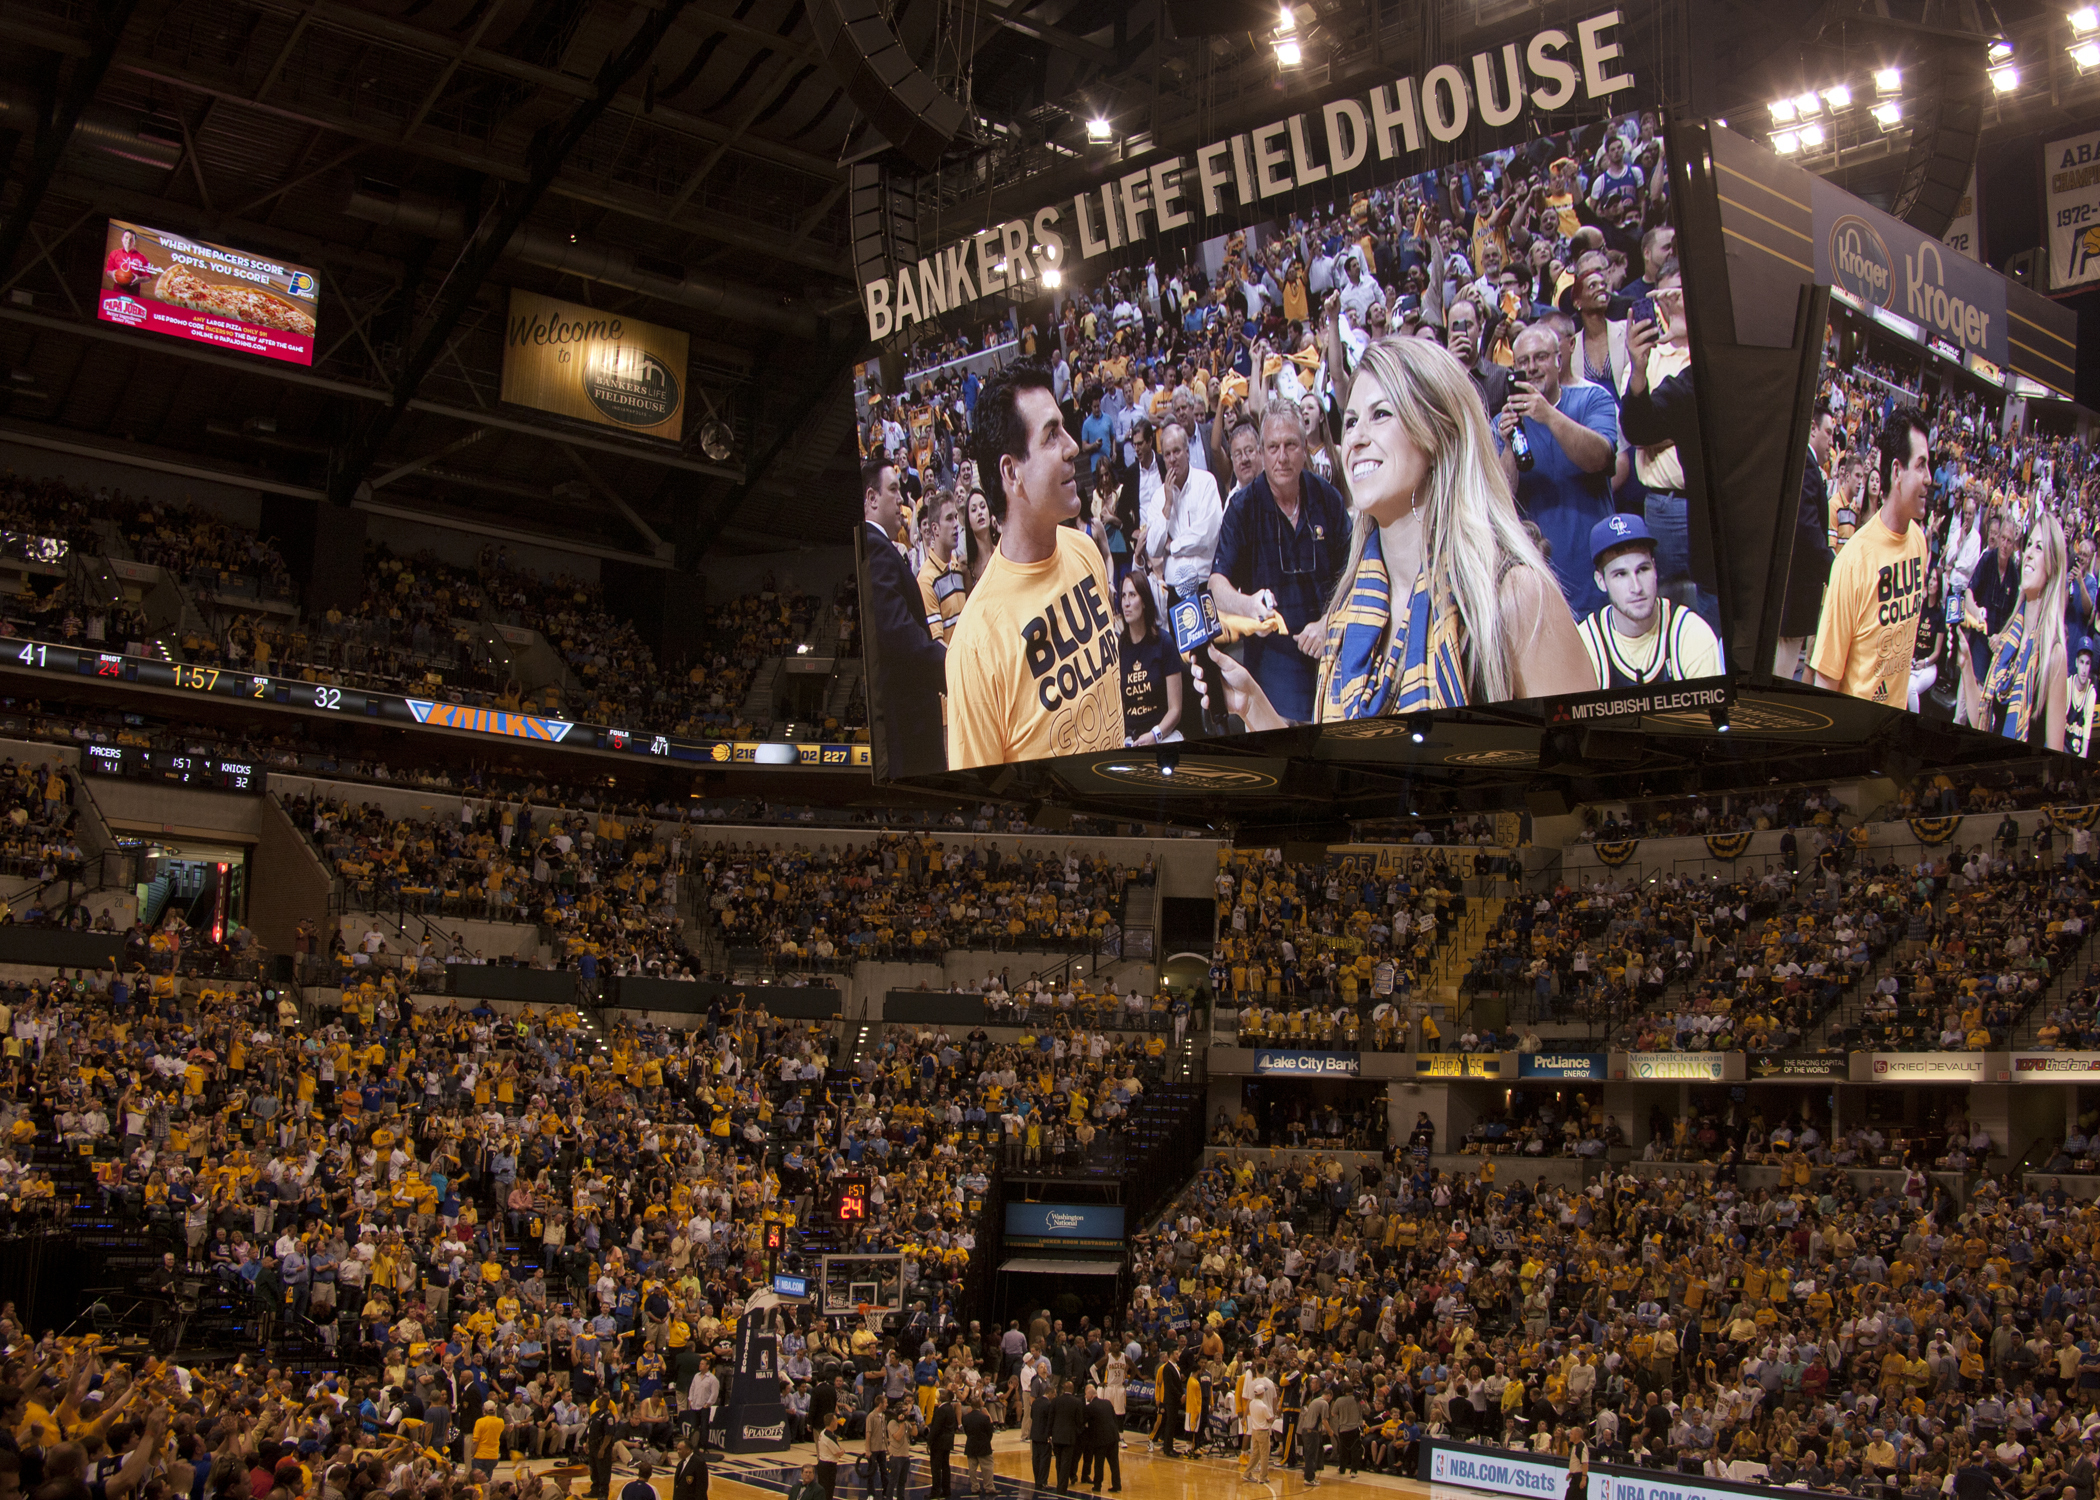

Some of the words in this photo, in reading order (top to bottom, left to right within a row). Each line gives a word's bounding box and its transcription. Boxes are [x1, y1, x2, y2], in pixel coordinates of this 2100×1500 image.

[865, 207, 1069, 341] BANKERS
[1074, 156, 1194, 260] LIFE
[1198, 9, 1635, 217] FIELDHOUSE
[2057, 201, 2100, 227] 1972-
[159, 237, 191, 253] WHEN
[193, 245, 211, 258] THE
[212, 250, 250, 267] PACERS
[250, 260, 284, 276] SCORE
[209, 262, 232, 275] YOU
[234, 268, 270, 284] SCORE!
[1839, 229, 1889, 301] Kroger
[1905, 241, 1990, 350] Kroger
[104, 300, 122, 313] PAPA
[153, 314, 165, 322] USE
[165, 316, 187, 326] PROMO
[188, 321, 204, 330] CODE
[234, 332, 246, 340] THE
[246, 334, 258, 342] DAY
[258, 336, 276, 346] AFTER
[276, 341, 287, 349] THE
[288, 344, 304, 353] GAME
[206, 318, 225, 328] LARGE
[226, 323, 242, 332] PIZZA
[243, 327, 258, 335] ONLY
[509, 312, 625, 347] Welcome
[191, 329, 213, 339] ONLINE
[219, 336, 267, 351] PAPAJOHNS.COM
[558, 347, 571, 363] to
[596, 376, 648, 395] BANKERS
[648, 388, 667, 400] LIFE
[594, 389, 667, 413] FIELDHOUSE
[611, 405, 647, 417] INDIANAPOLIS
[1877, 556, 1922, 603] BLUE
[1021, 574, 1110, 680] BLUE
[1876, 616, 1919, 659] GOL
[19, 643, 47, 667] 41
[101, 654, 122, 663] SHOT
[99, 660, 119, 677] 24
[1039, 628, 1119, 713] COLLAR
[172, 665, 220, 691] 1:57
[253, 676, 269, 685] QTR
[1127, 670, 1148, 684] KEEP
[254, 683, 265, 698] 2
[1125, 681, 1152, 697] CALM
[314, 686, 341, 710] 32
[1572, 698, 1650, 719] MITSUBISHI
[1653, 689, 1726, 710] ELECTRIC
[609, 729, 629, 738] FOULS
[614, 736, 623, 749] 5
[651, 742, 669, 755] 4/1
[89, 745, 122, 759] PACERS
[801, 750, 817, 761] 02
[823, 751, 847, 763] 227
[104, 761, 118, 772] 41
[173, 757, 191, 768] 1:57
[221, 762, 251, 775] KNICKS
[183, 773, 190, 782] 2
[235, 776, 248, 788] 32
[1497, 826, 1514, 843] 55
[1450, 853, 1473, 879] 55
[1264, 1055, 1296, 1069] Lake
[1298, 1056, 1324, 1072] City
[1325, 1057, 1359, 1071] Bank
[1534, 1055, 1591, 1069] ProLiance
[1629, 1054, 1723, 1063] MonoFoilClean.com
[1784, 1059, 1796, 1067] THE
[1889, 1062, 1925, 1071] KRIEG
[1469, 1058, 1483, 1076] 55
[1563, 1070, 1590, 1078] ENERGY
[1655, 1062, 1711, 1079] GERMS
[848, 1184, 865, 1197] 1:57
[840, 1197, 862, 1220] 24
[1051, 1213, 1084, 1221] Washington
[1053, 1219, 1078, 1227] National
[768, 1233, 780, 1248] 24
[1494, 1230, 1514, 1245] 3-1
[781, 1280, 804, 1293] NBA.COM
[1169, 1304, 1185, 1317] GO
[740, 1328, 751, 1374] NBA.COM
[755, 1371, 766, 1379] NBA
[766, 1371, 774, 1379] TV
[748, 1426, 784, 1438] PLAYOFFS
[1449, 1458, 1556, 1492] NBA.COM/Stats
